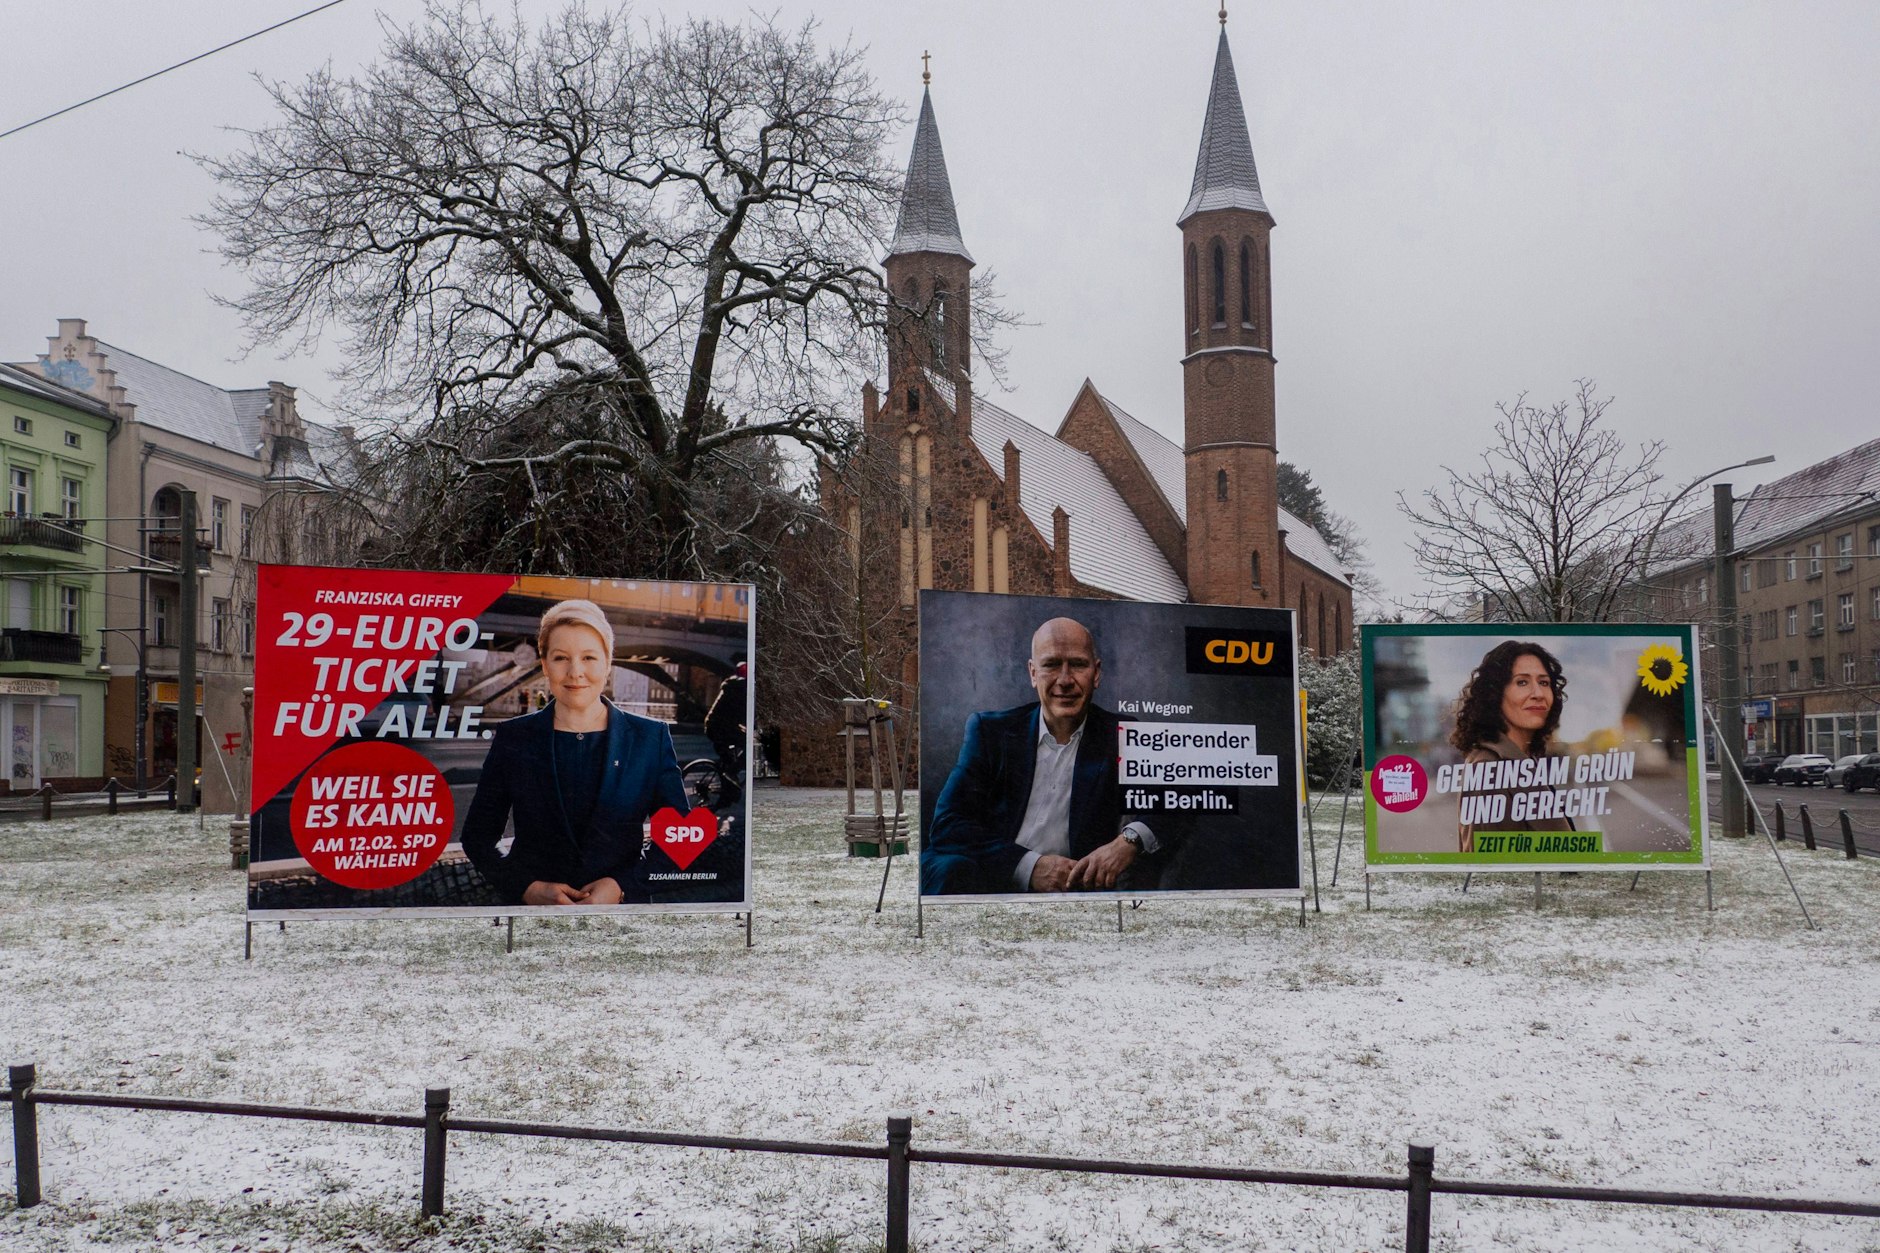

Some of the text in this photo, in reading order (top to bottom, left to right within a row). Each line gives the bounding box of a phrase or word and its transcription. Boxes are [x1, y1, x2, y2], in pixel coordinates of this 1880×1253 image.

[315, 590, 463, 608] FRANZISKA GIFFEY
[275, 612, 495, 651] 29-EURO-
[1204, 639, 1274, 665] CDU
[312, 657, 467, 694] TICKET
[273, 694, 493, 740] FÜR ALLE.
[1118, 700, 1193, 716] Kai Wegner
[1126, 729, 1250, 751] Regierender
[1126, 760, 1273, 782] Bürgermeister
[1435, 748, 1635, 794] GEMEINSAM GRÜN
[310, 774, 436, 800] WEIL SIE
[1384, 788, 1418, 805] wählen!
[1125, 789, 1233, 810] für Berlin.
[1460, 786, 1612, 826] UND GERECHT.
[304, 802, 444, 828] ES KANN.
[311, 833, 437, 853] AM 12.02. SPD
[665, 827, 704, 843] SPD
[1478, 834, 1599, 853] ZEIT FÜR JARASCH.
[333, 852, 418, 870] WÄHLEN!
[648, 872, 718, 881] ZUSAMMEN BERLIN
